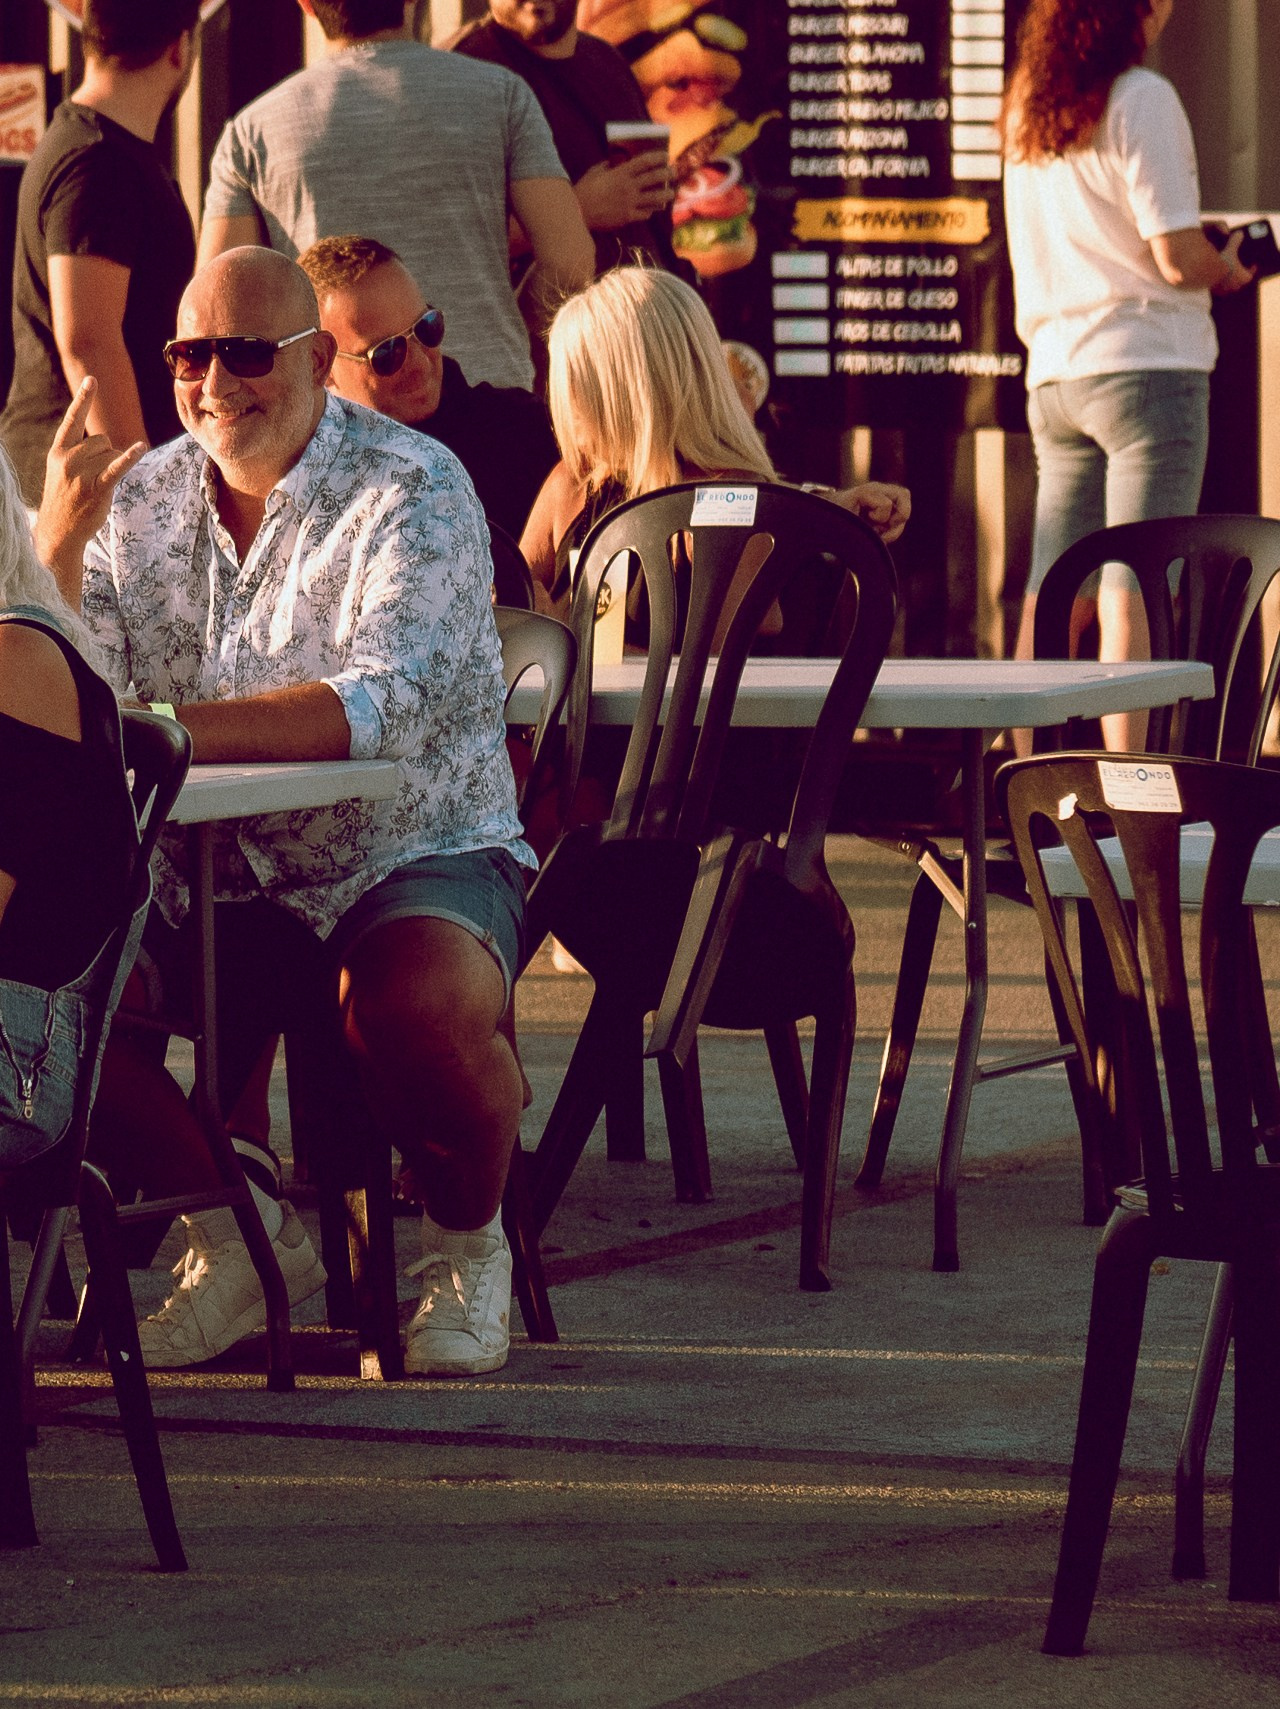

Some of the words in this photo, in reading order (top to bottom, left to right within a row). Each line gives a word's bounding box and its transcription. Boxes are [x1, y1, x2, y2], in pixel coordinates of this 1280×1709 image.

[884, 255, 904, 277] DE
[906, 255, 958, 278] POLLO
[885, 287, 906, 310] DE
[907, 287, 959, 310] QUESO
[871, 320, 892, 342] DE
[893, 320, 961, 343] CEBOLLA
[709, 492, 755, 503] REDONDO
